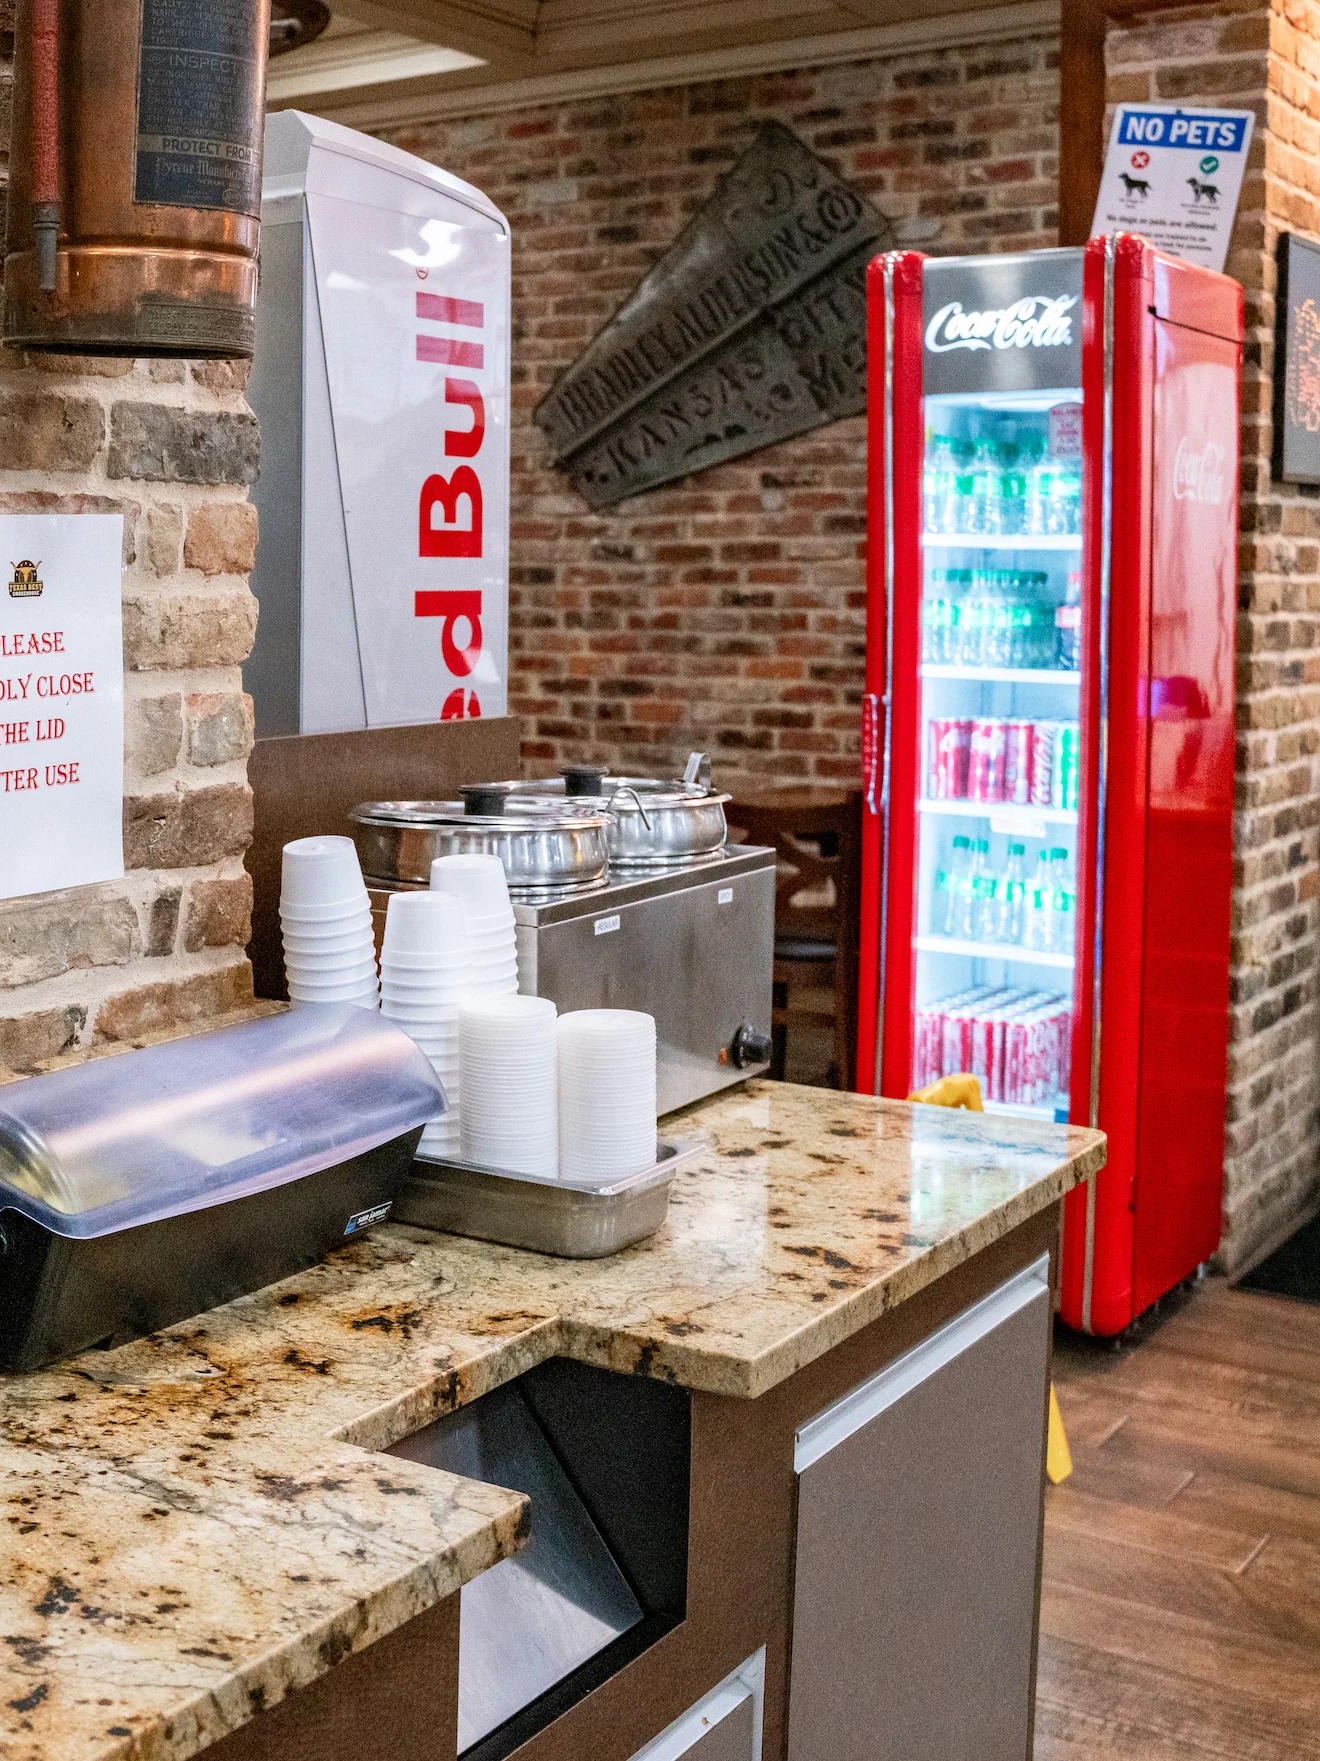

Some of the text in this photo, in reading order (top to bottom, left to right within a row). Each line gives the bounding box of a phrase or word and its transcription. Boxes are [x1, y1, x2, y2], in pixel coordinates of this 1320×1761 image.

[1125, 116, 1237, 147] NO PETS
[162, 138, 251, 161] PROTECT FROM
[604, 353, 765, 476] KANSAS
[415, 291, 485, 723] ed Bull
[36, 672, 95, 699] CLOSE
[35, 718, 65, 742] LID
[45, 762, 81, 787] USE
[597, 918, 618, 931] REGULAR
